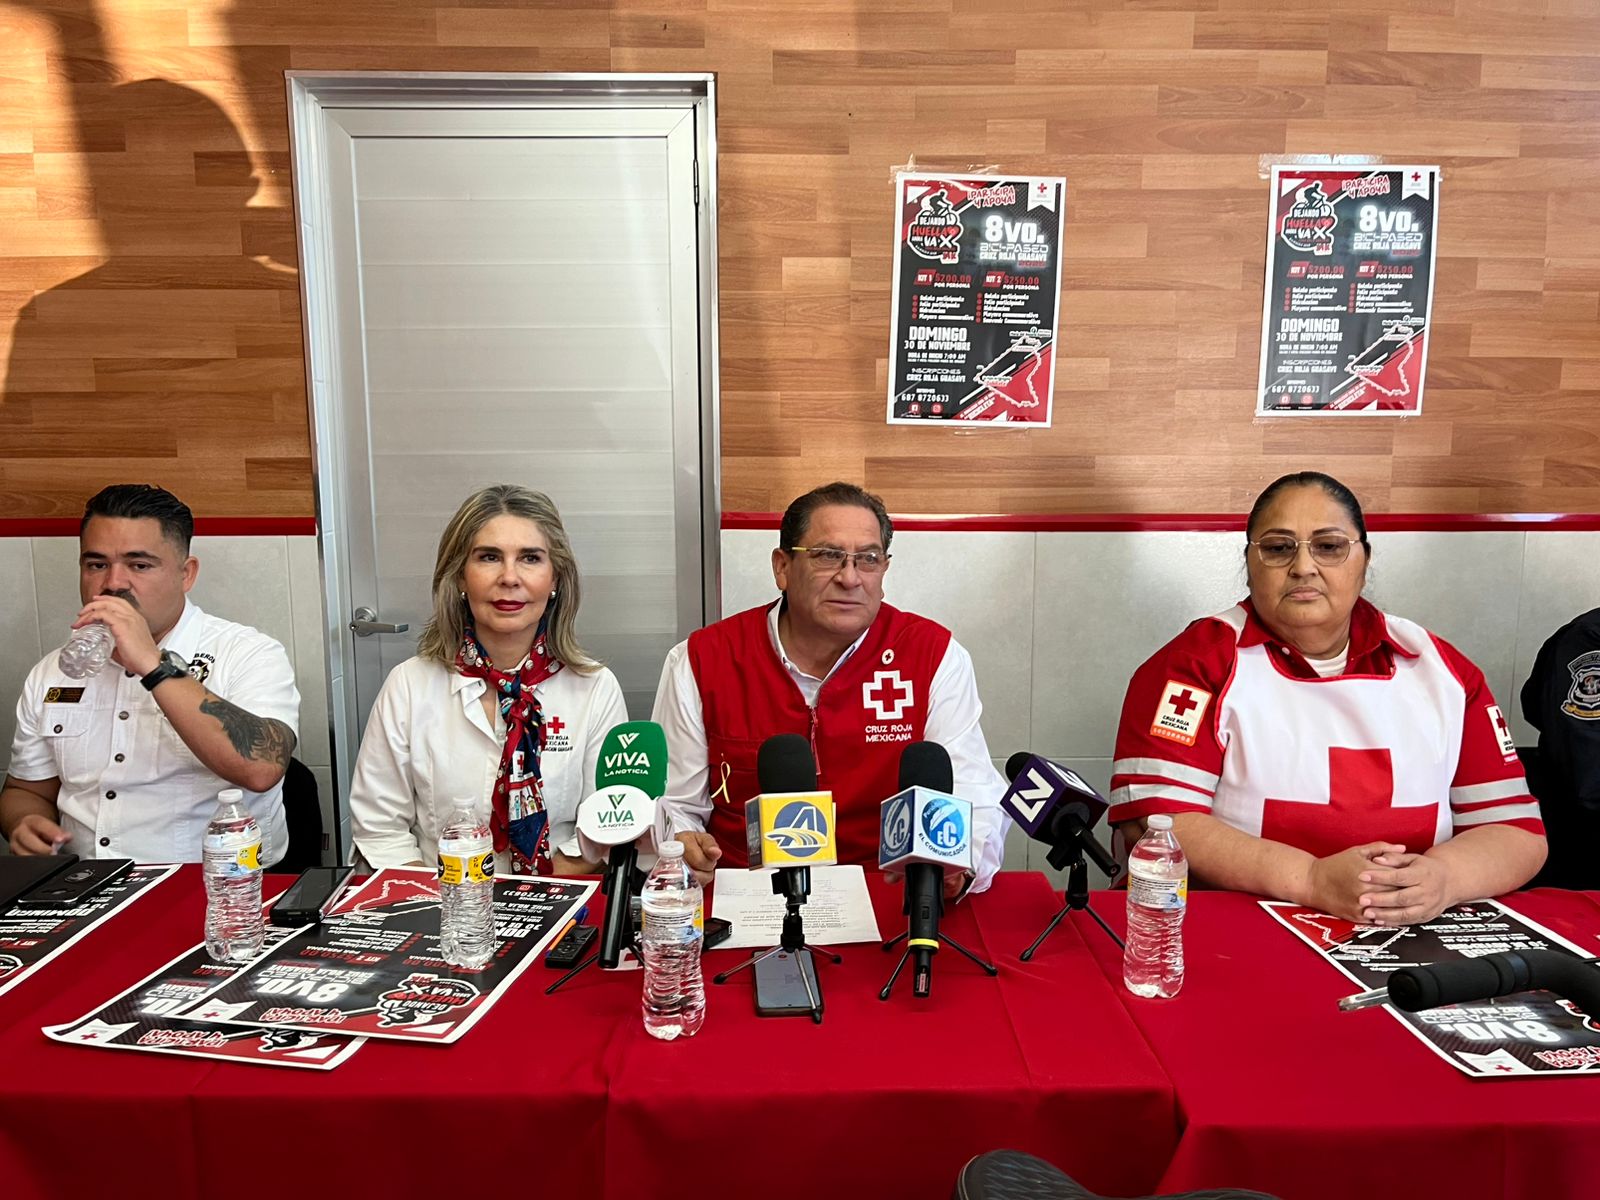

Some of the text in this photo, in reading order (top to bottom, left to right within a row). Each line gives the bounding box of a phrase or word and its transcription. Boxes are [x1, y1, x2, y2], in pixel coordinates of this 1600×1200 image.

[1281, 318, 1339, 332] DOMINGO
[909, 326, 967, 341] DOMINGO
[1276, 332, 1342, 341] 30 DE NOVIEMBRE
[904, 340, 971, 351] 30 DE NOVIEMBRE
[1160, 720, 1187, 731] MEXICANA
[1176, 718, 1189, 726] ROJA
[891, 724, 912, 732] ROJA
[865, 733, 912, 742] MEXICANA
[604, 752, 650, 768] VIVA
[598, 810, 634, 824] VIVA
[937, 821, 957, 847] EC
[918, 832, 967, 857] EL COMUNICADOR
[403, 1001, 448, 1010] DEJANDO
